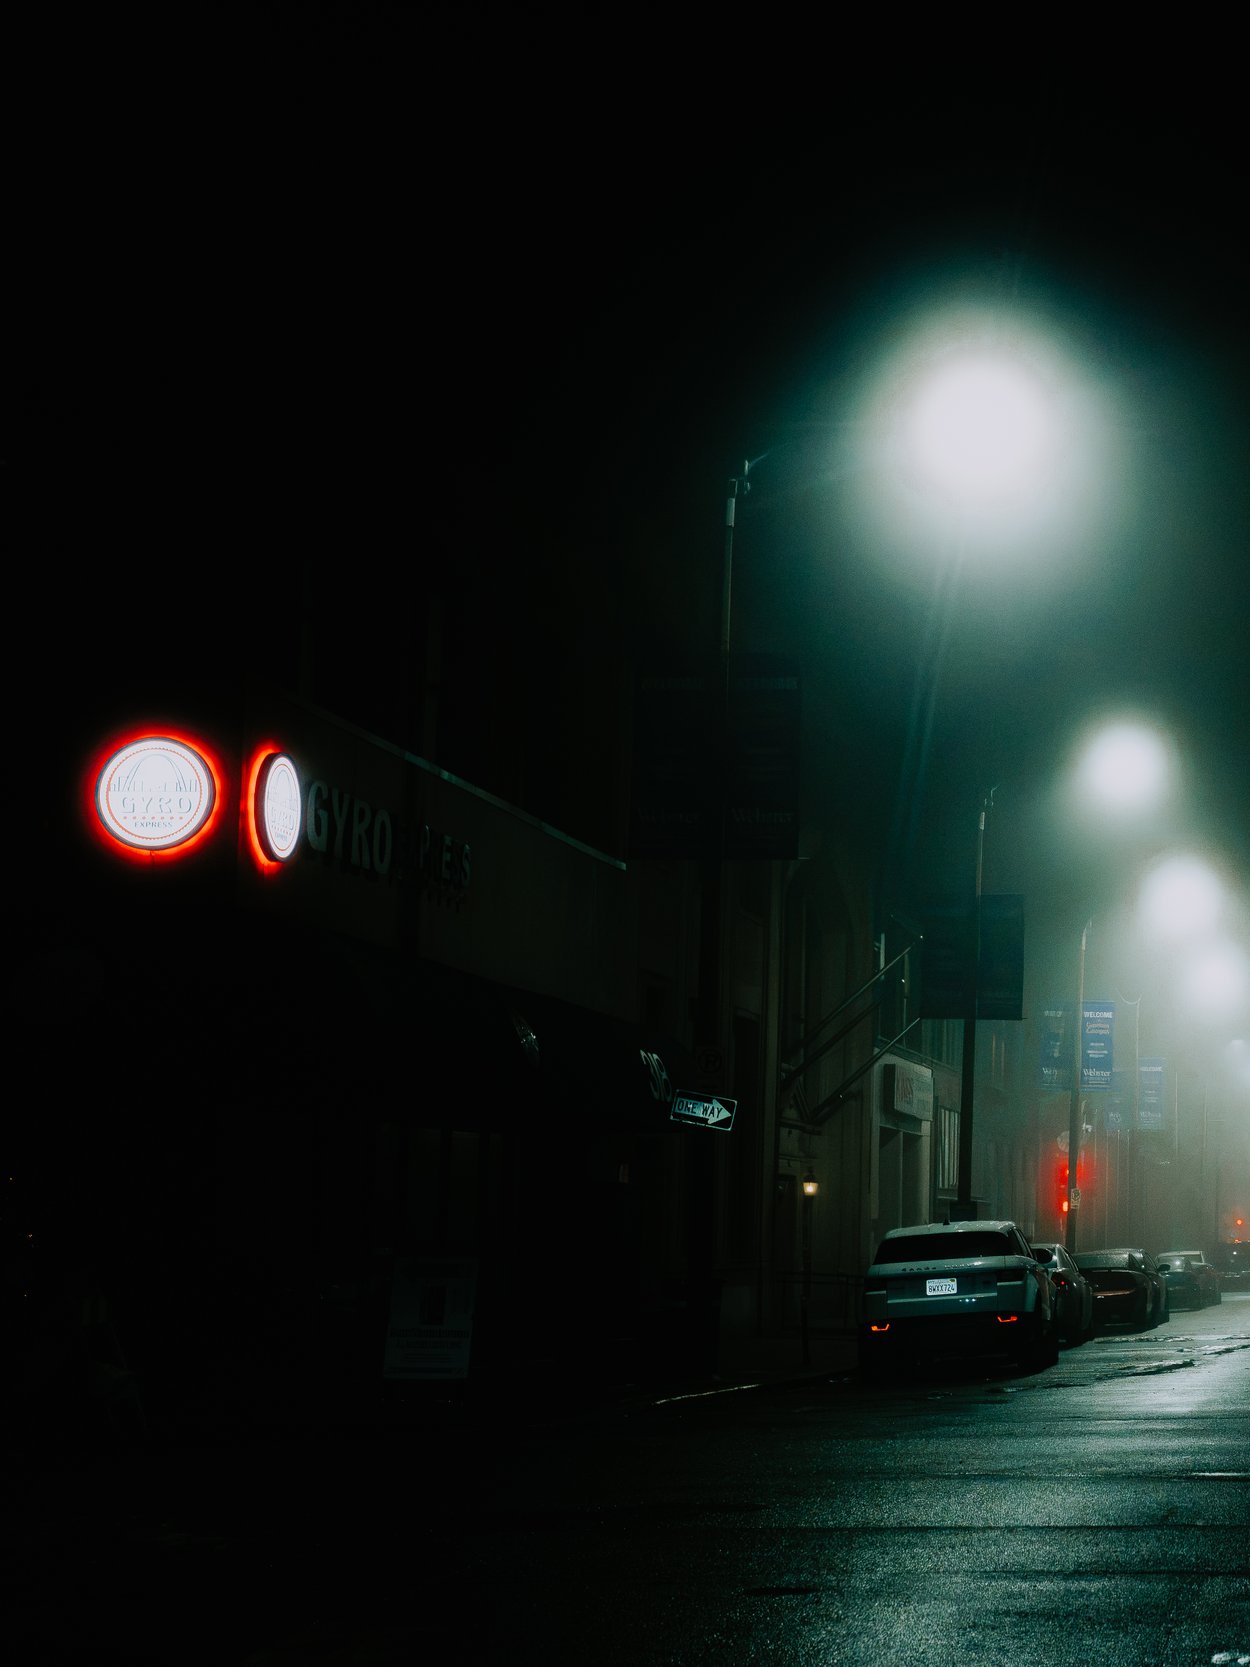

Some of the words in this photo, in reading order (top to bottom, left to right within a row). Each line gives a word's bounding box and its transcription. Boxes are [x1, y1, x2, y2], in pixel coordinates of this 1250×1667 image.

[120, 796, 192, 814] GYRO
[306, 779, 394, 876] GYRO
[1083, 1011, 1113, 1019] WELCOME
[1083, 1068, 1112, 1077] Webster
[677, 1100, 697, 1115] ONE
[701, 1103, 723, 1118] WAY
